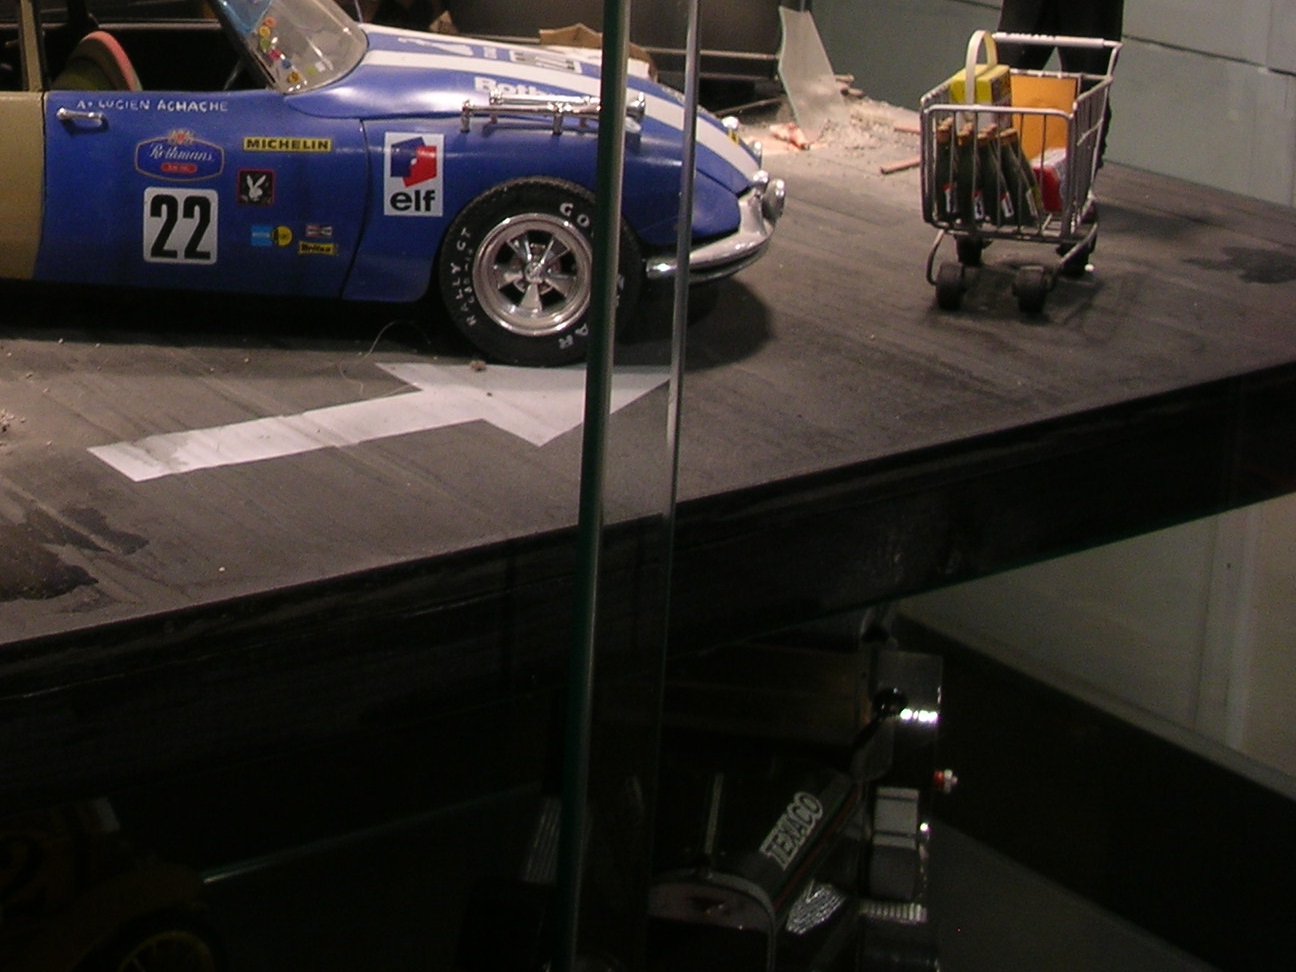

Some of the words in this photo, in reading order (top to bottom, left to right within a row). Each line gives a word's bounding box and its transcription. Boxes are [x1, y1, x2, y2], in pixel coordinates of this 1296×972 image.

[246, 138, 330, 150] MICHELIN
[389, 189, 437, 212] elf
[150, 194, 211, 260] 22
[760, 792, 823, 870] TEXACO
